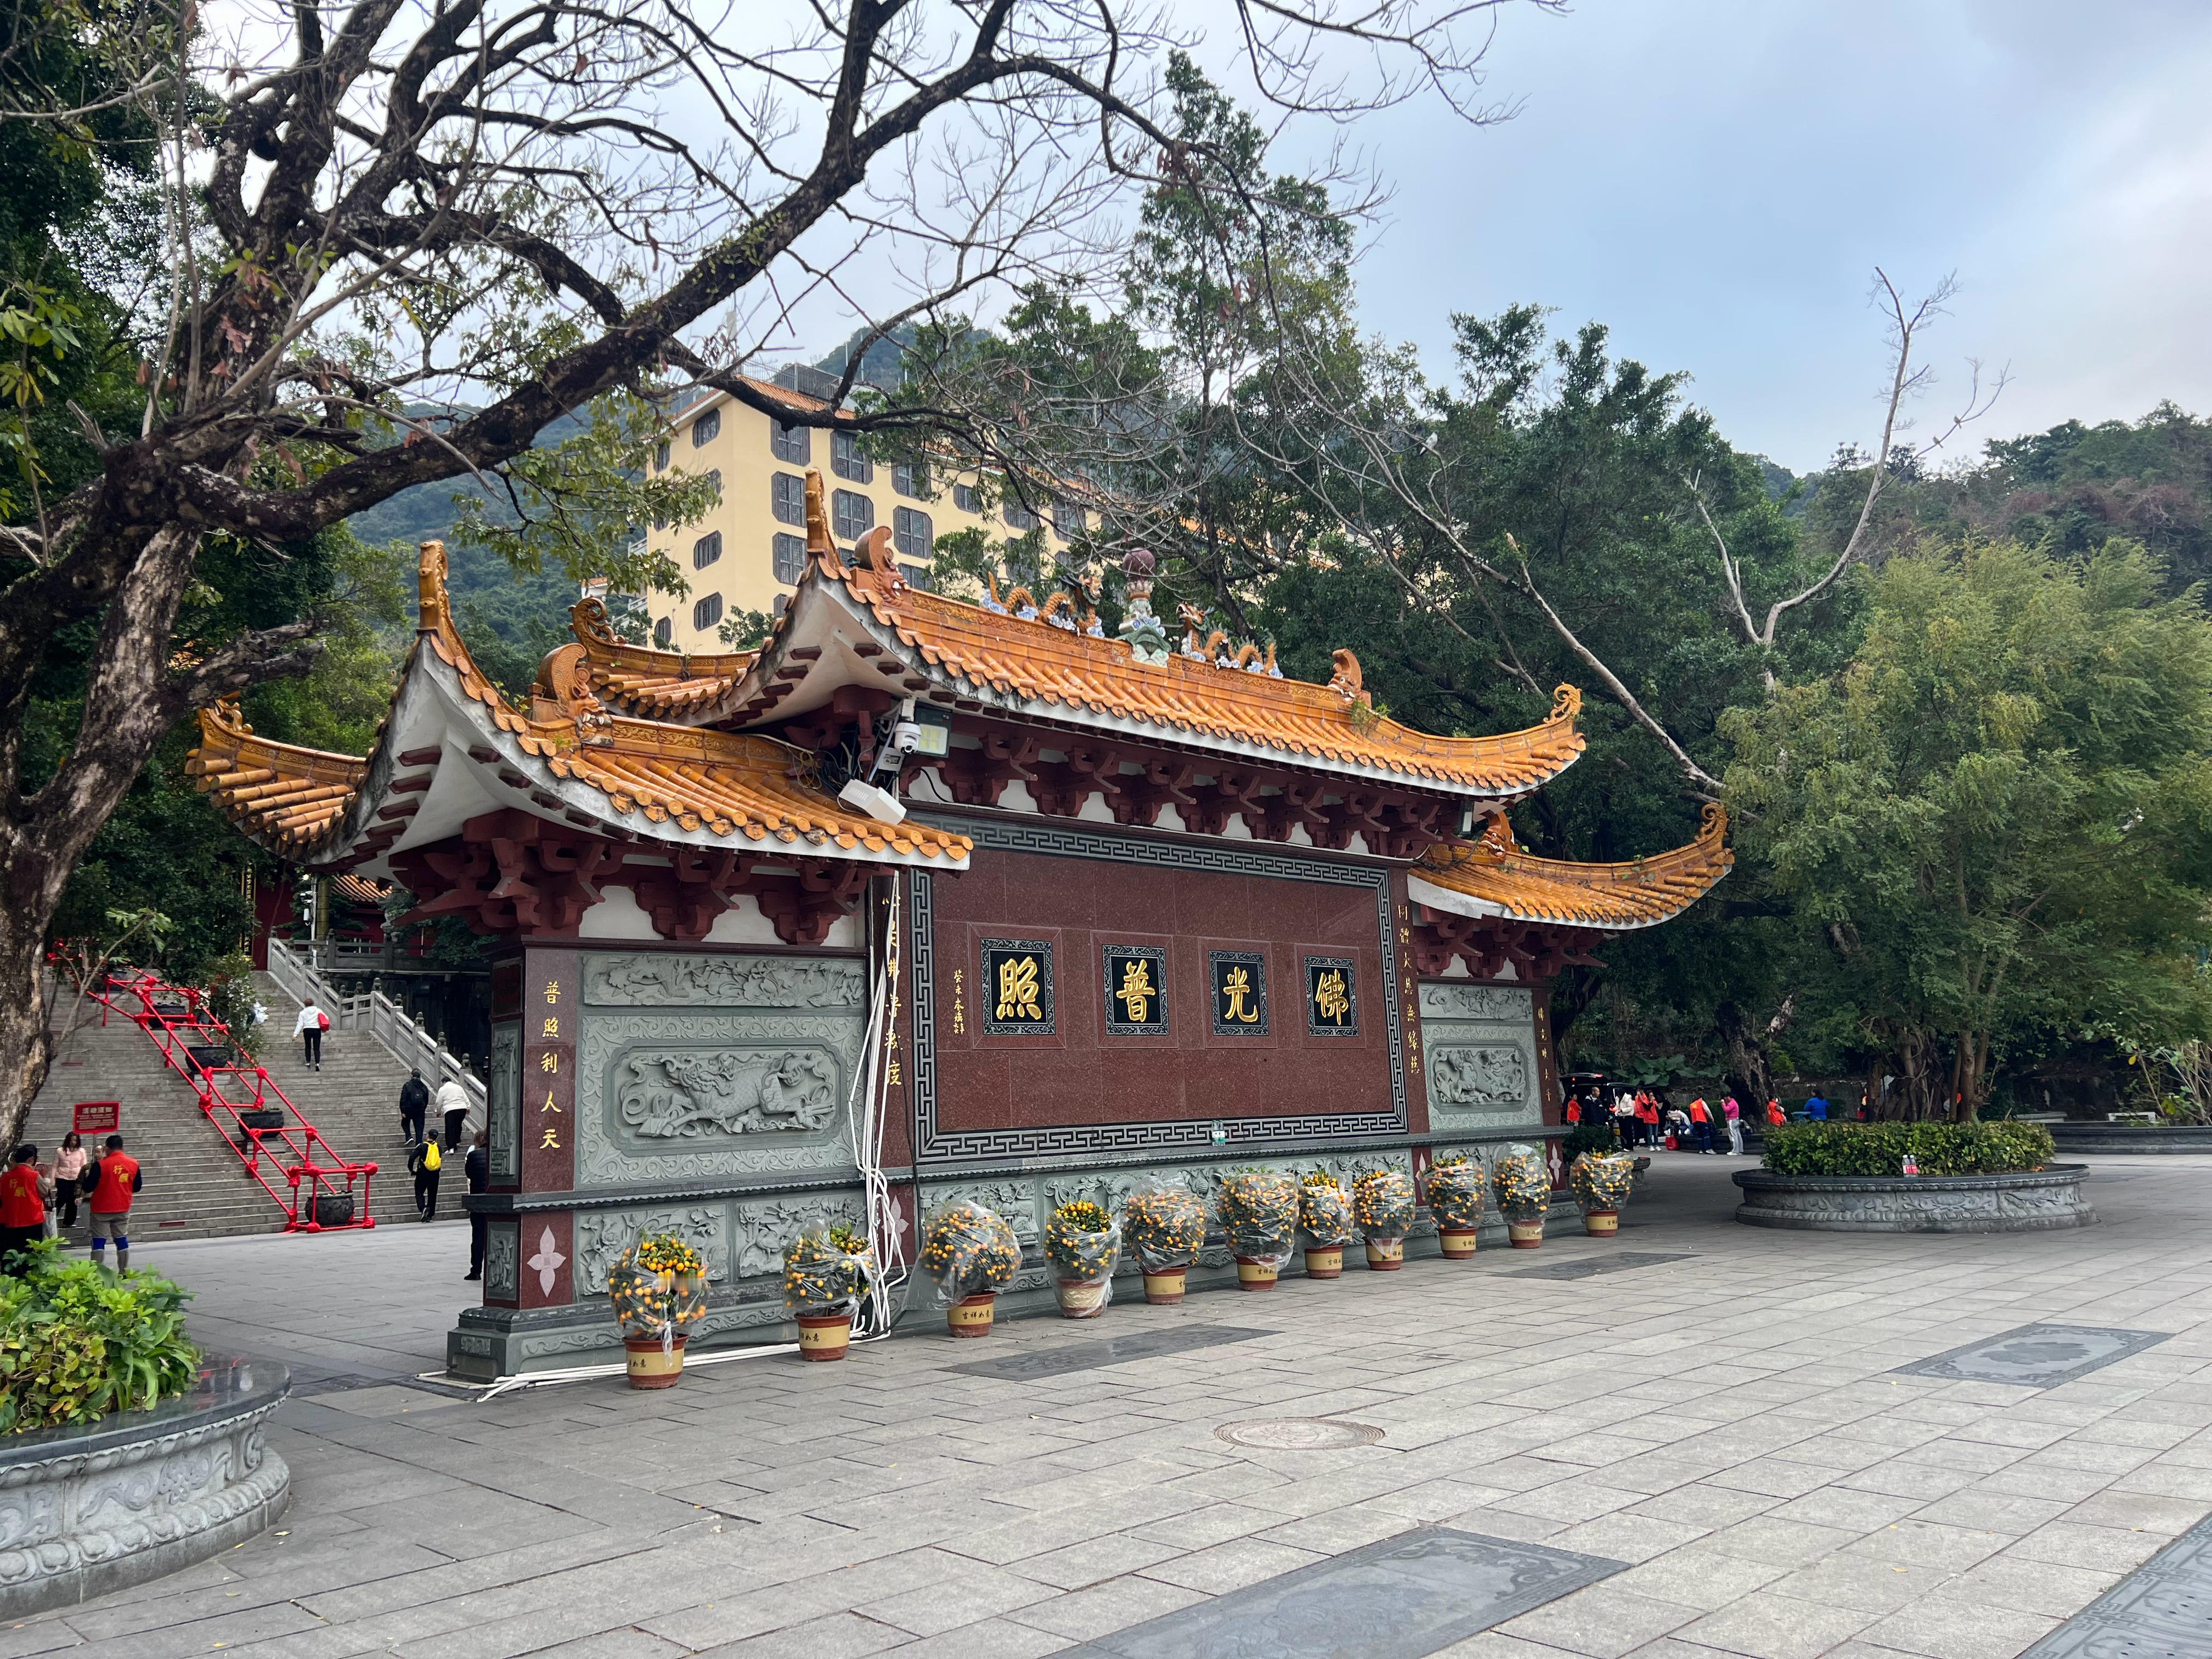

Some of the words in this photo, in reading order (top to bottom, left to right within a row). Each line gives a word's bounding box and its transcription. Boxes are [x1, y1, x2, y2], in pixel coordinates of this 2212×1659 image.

[540, 981, 562, 1149] 普照利人天
